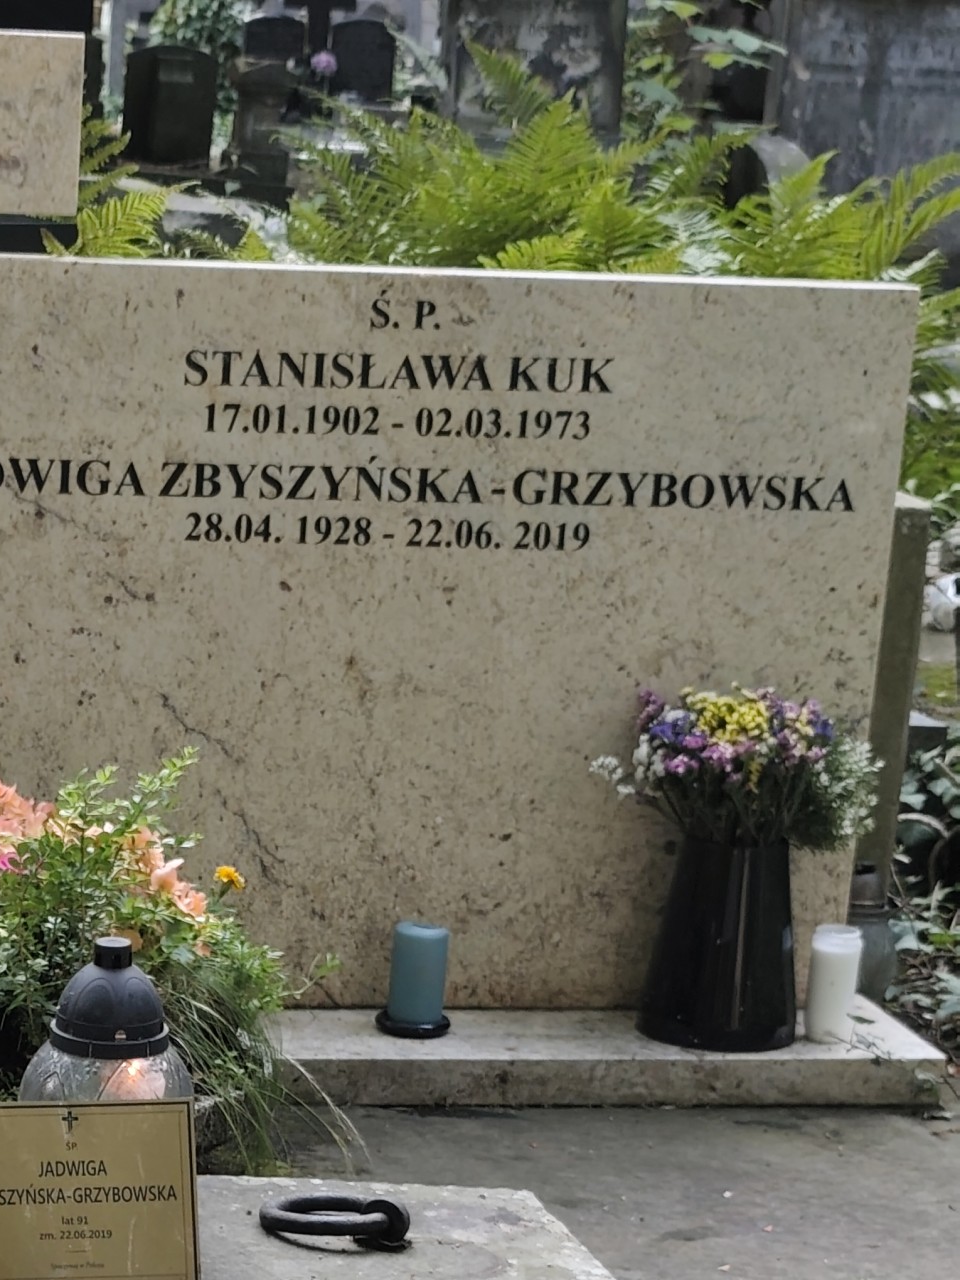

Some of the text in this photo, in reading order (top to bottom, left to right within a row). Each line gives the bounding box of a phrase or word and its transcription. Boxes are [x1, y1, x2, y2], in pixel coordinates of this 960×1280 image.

[369, 291, 441, 330] Ś. P.
[183, 349, 616, 395] STANISŁAWA KUK
[203, 403, 380, 436] 17.01.1902
[415, 406, 591, 440] 02.03.1973
[38, 1160, 108, 1178] JADWIGA
[61, 1215, 89, 1225] lat 91
[39, 1229, 113, 1241] zm. 22.06.2019
